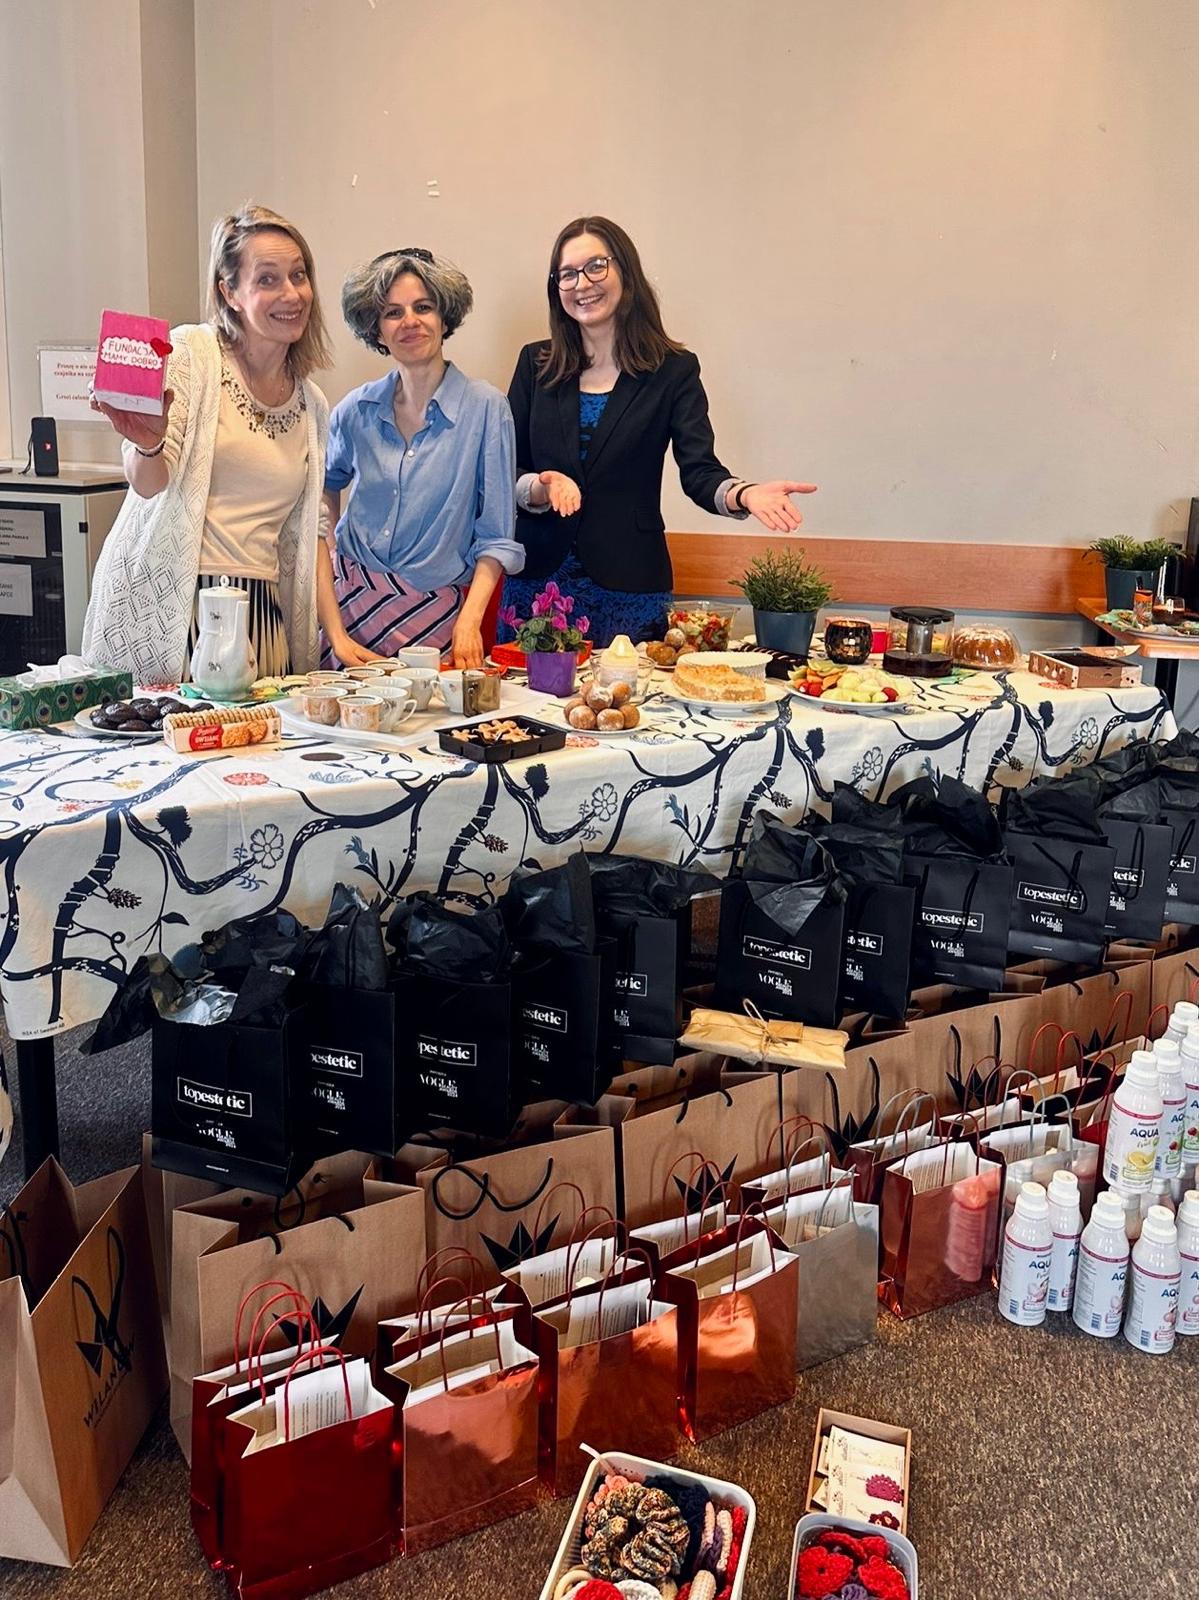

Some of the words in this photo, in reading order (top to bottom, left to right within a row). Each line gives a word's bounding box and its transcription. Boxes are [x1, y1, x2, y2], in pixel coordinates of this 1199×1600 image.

[108, 340, 155, 358] FUNDACJA
[104, 352, 127, 362] MAMY
[131, 357, 158, 366] DOBRO
[1130, 1128, 1159, 1138] AQUA
[1161, 1288, 1179, 1297] AQ
